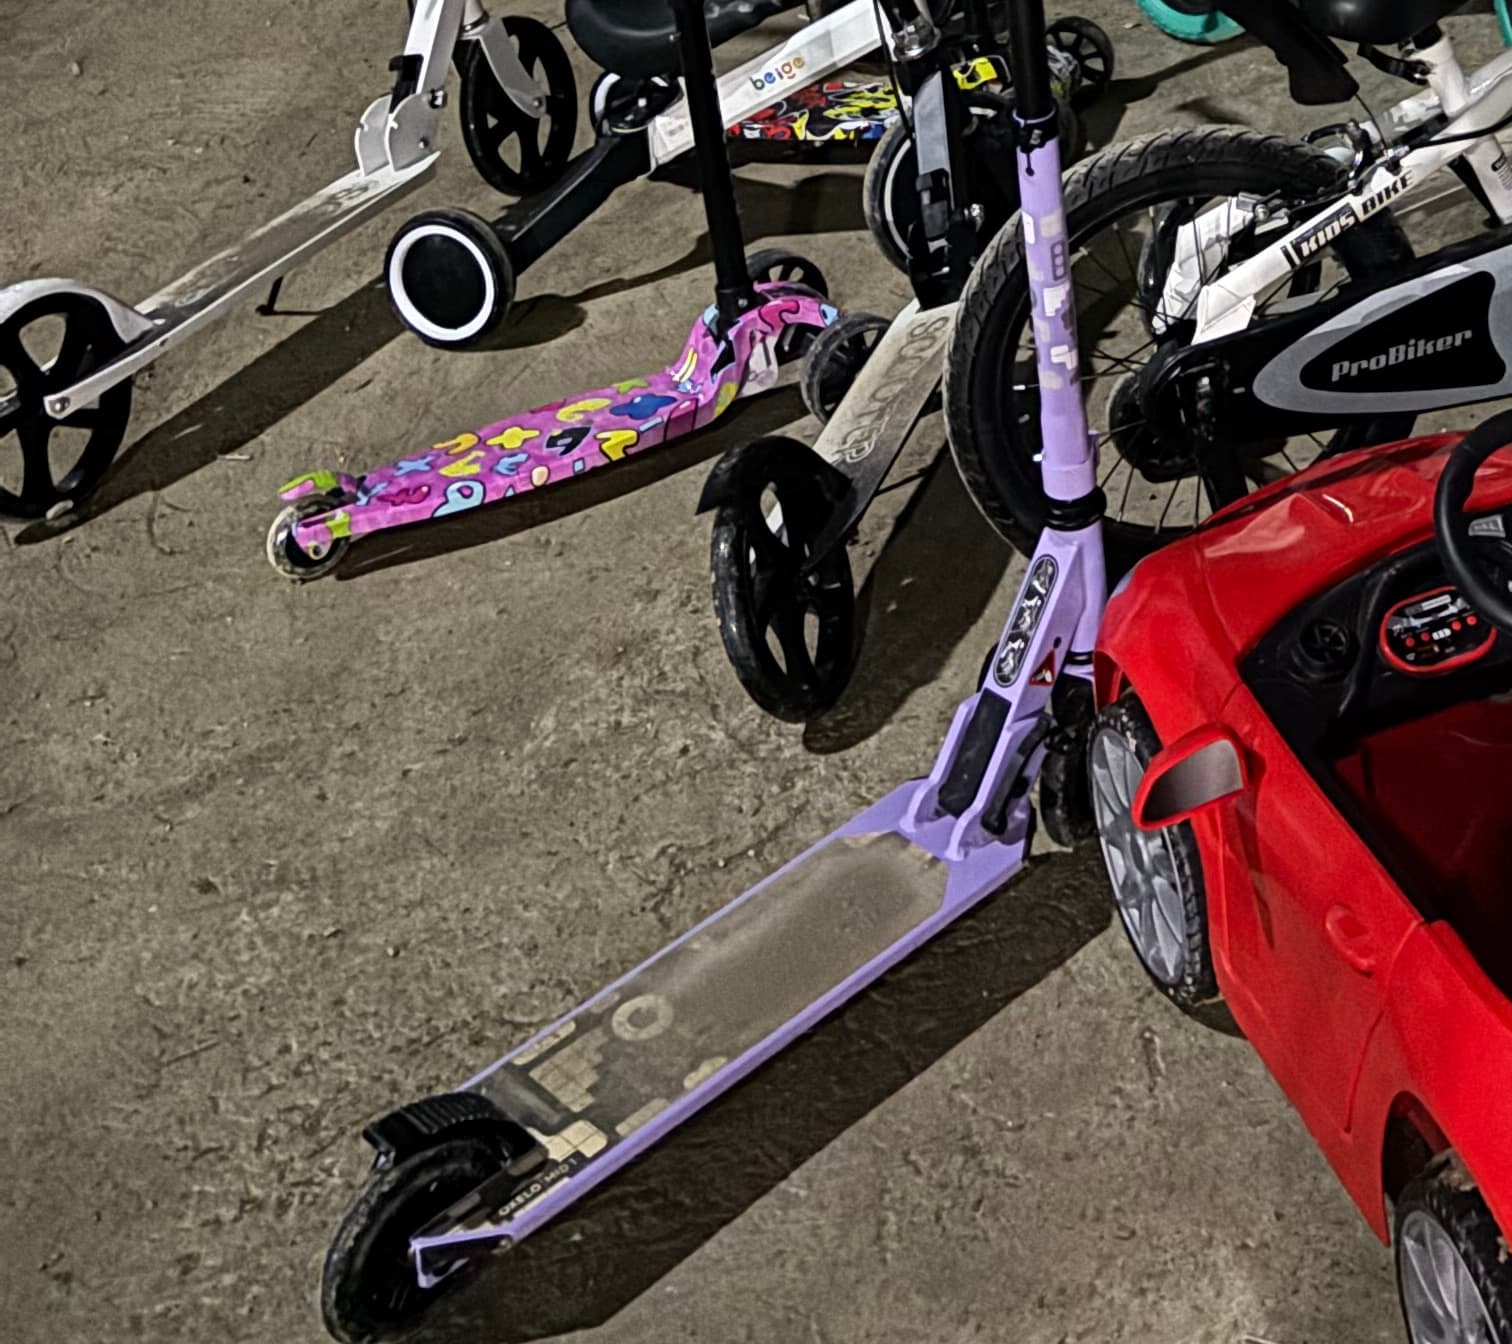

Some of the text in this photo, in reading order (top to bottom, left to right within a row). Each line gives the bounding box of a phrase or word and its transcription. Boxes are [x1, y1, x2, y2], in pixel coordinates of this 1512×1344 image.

[749, 57, 805, 90] beige
[1300, 169, 1415, 257] KIDS BIKE
[1331, 329, 1473, 383] ProBiker
